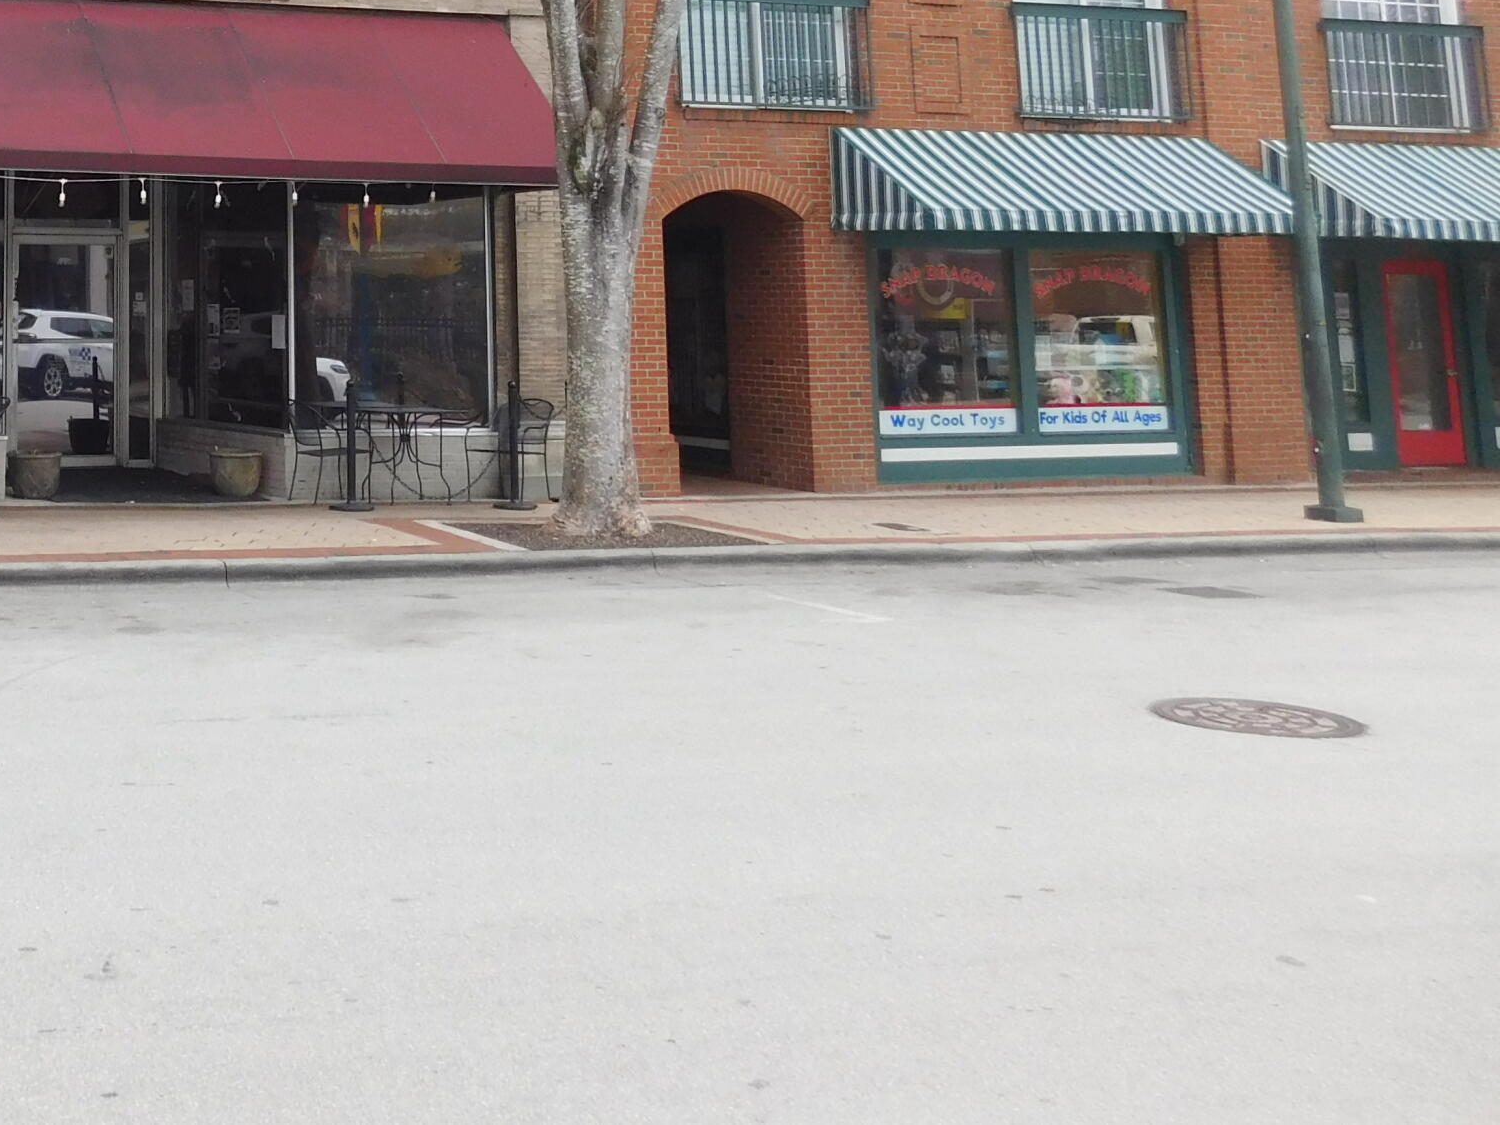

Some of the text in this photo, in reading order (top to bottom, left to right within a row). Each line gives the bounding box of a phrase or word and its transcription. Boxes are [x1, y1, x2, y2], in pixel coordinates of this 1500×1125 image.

[925, 263, 997, 296] DRAGON
[890, 413, 1005, 430] Way Cool Toys
[1039, 410, 1162, 426] For Kids Of All Ages
